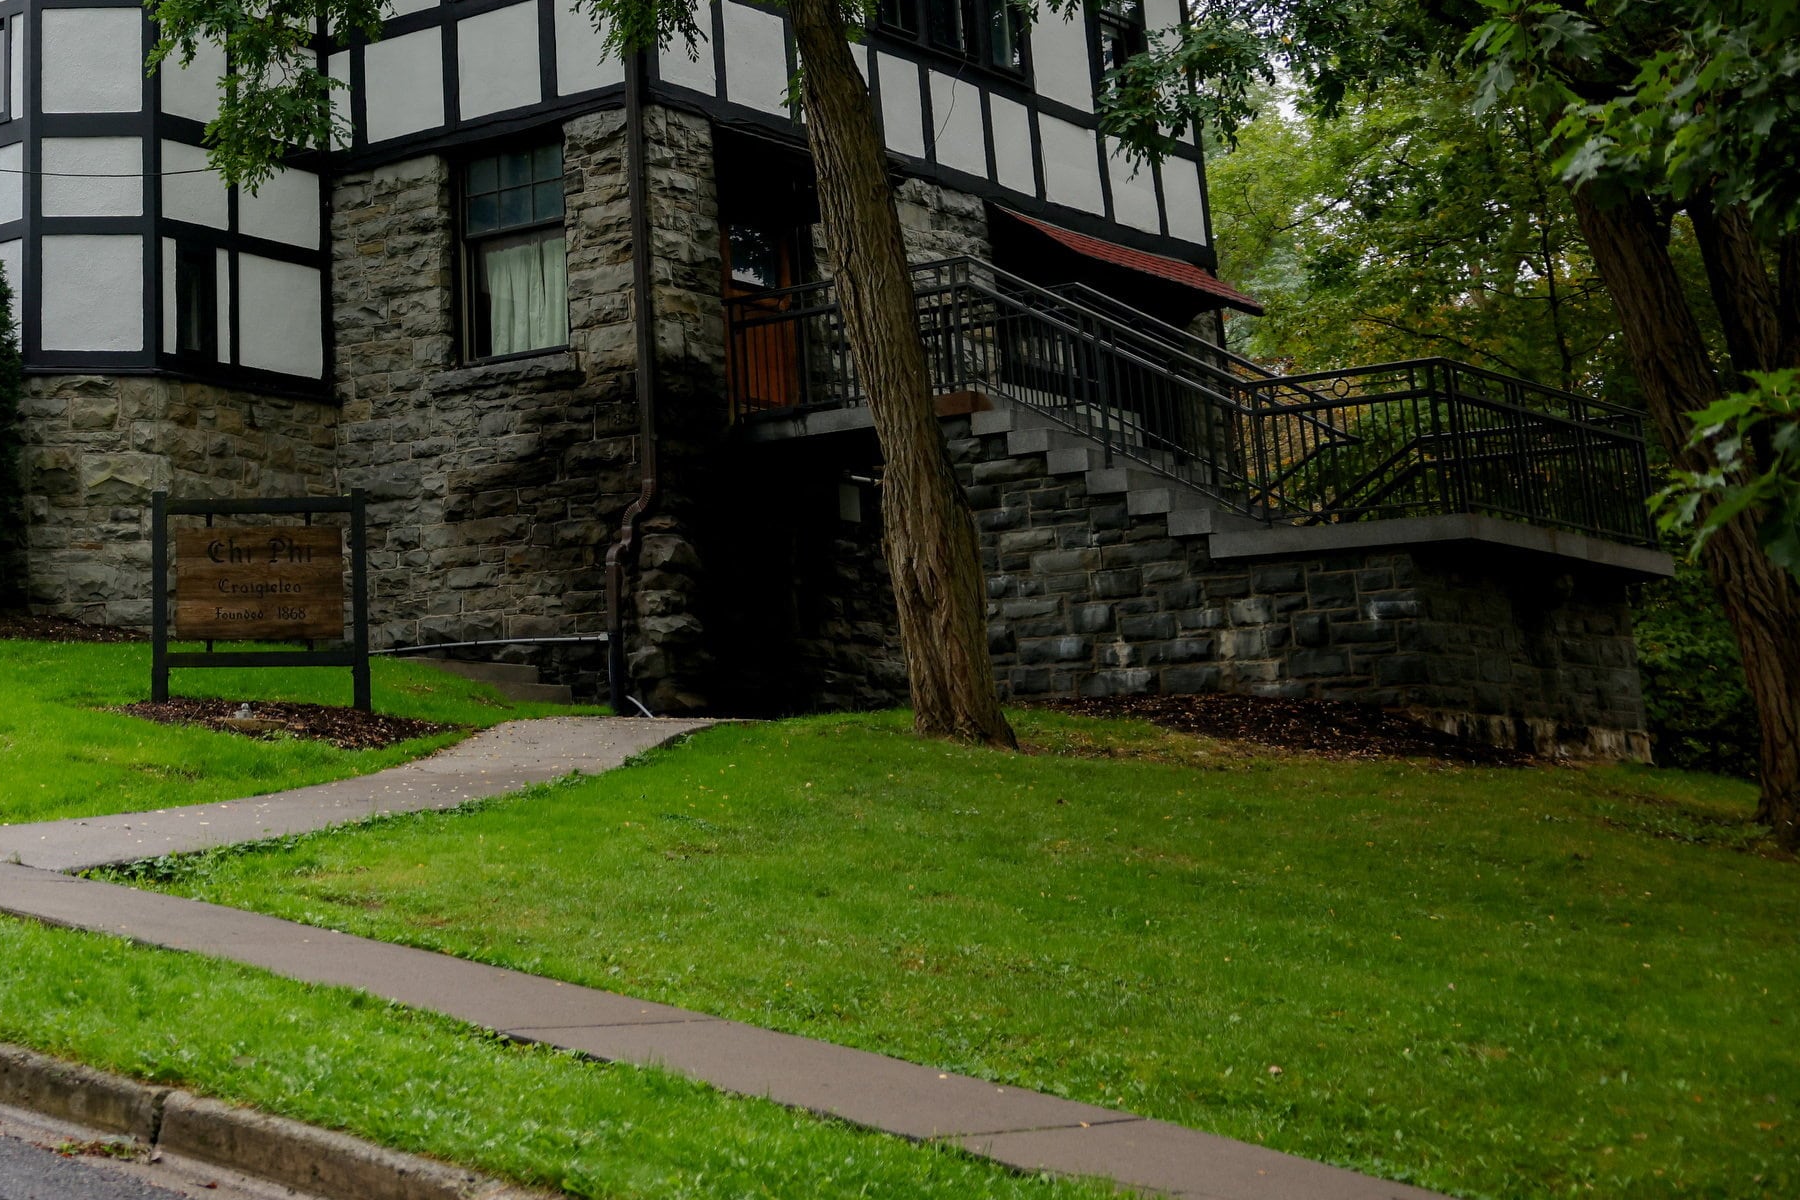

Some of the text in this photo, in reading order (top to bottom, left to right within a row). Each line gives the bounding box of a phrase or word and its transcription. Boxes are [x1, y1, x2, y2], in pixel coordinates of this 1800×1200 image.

[207, 535, 312, 564] Chi Phi
[218, 578, 301, 599] Craigielea
[215, 606, 306, 620] Founded 1868
